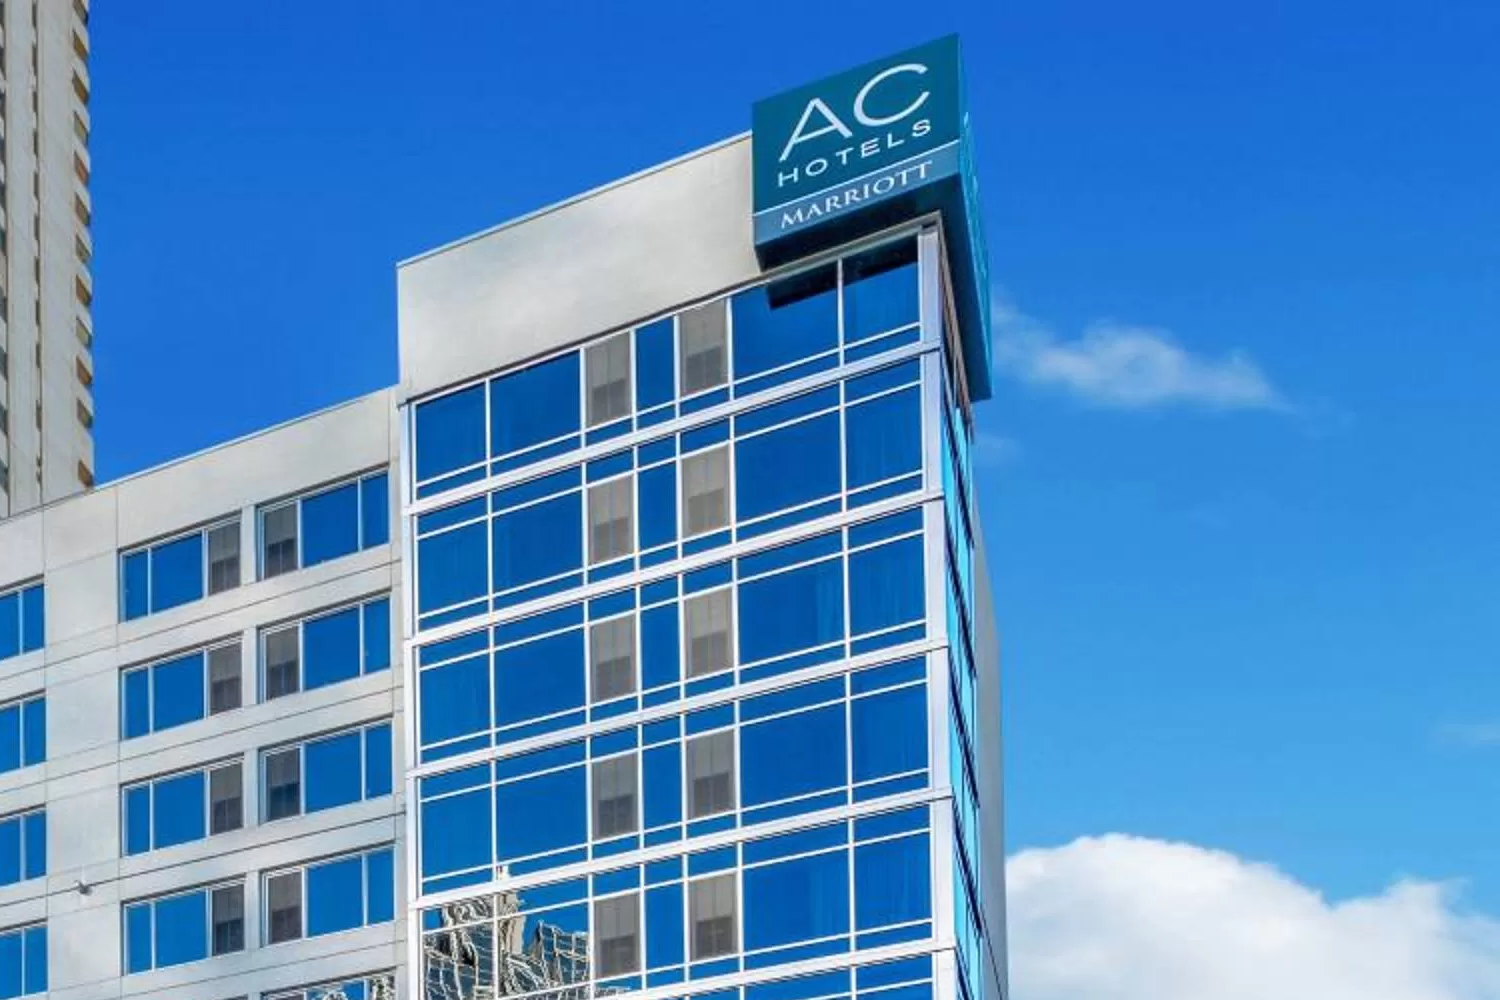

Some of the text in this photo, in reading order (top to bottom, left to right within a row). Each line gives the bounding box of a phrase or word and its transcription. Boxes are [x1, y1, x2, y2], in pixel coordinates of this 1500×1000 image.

[778, 63, 930, 163] AC
[777, 119, 931, 188] HOTELS
[780, 160, 933, 229] MARRIOTT
